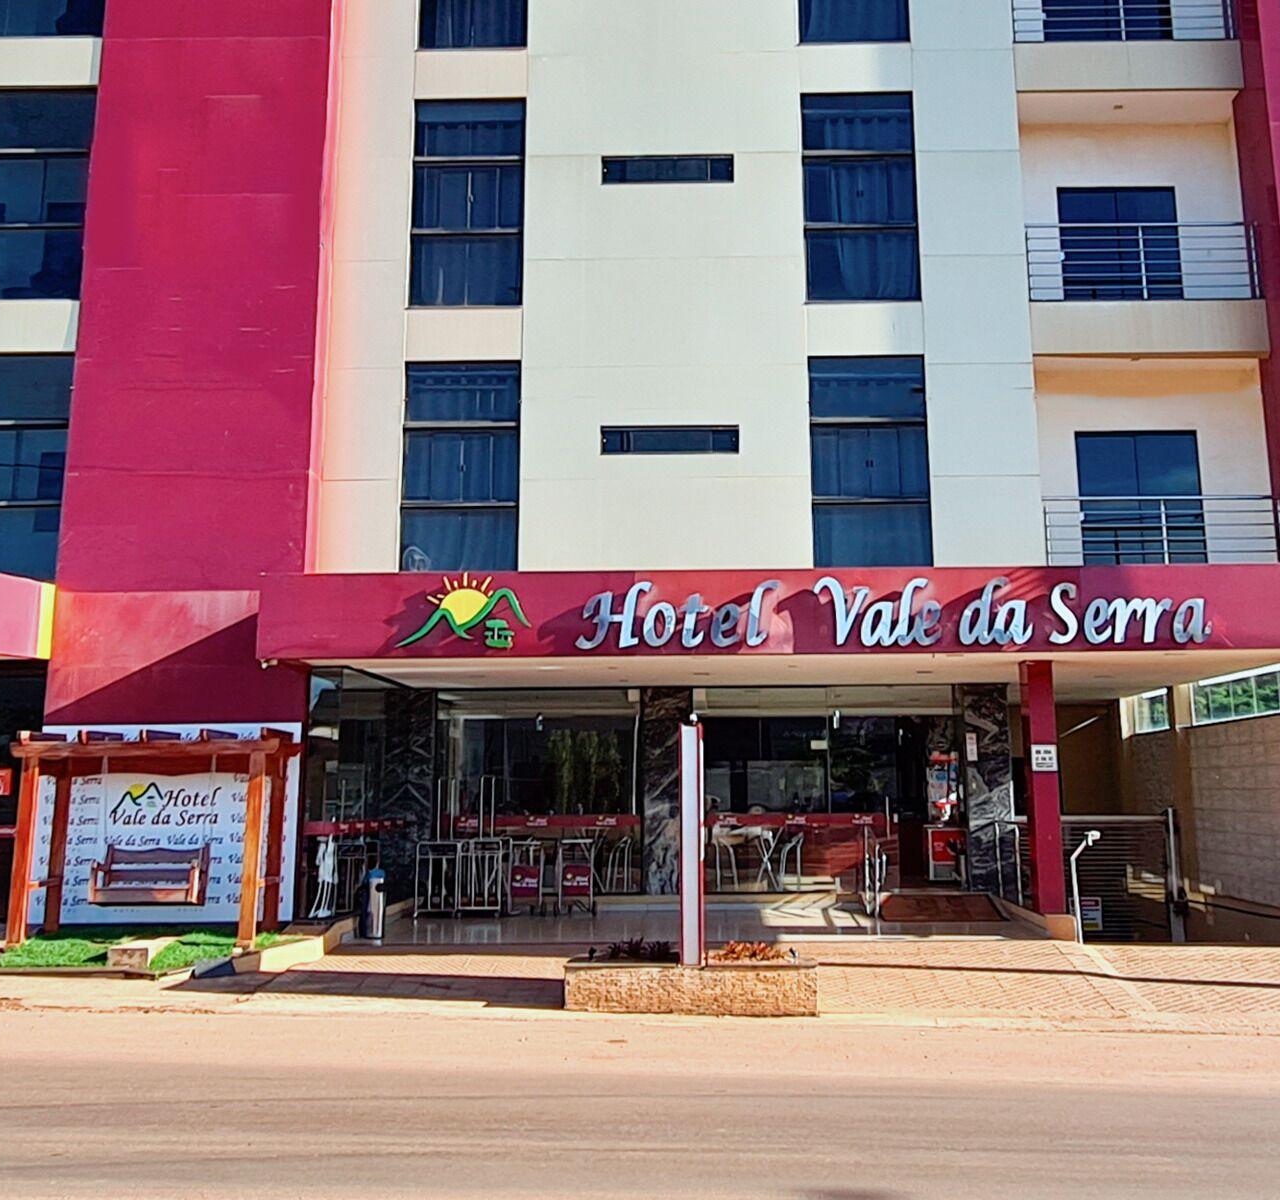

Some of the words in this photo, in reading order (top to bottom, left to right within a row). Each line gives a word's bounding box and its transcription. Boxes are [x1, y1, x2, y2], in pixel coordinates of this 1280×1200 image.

[574, 579, 781, 650] Hotel
[813, 576, 942, 648] Vale
[959, 576, 1034, 646] da
[1048, 582, 1212, 645] Serra
[163, 786, 222, 810] Hotel
[110, 808, 147, 826] Vale
[151, 806, 171, 826] da
[175, 808, 219, 827] Serra
[137, 835, 161, 848] Serra
[167, 834, 186, 846] Vale
[188, 833, 199, 846] da
